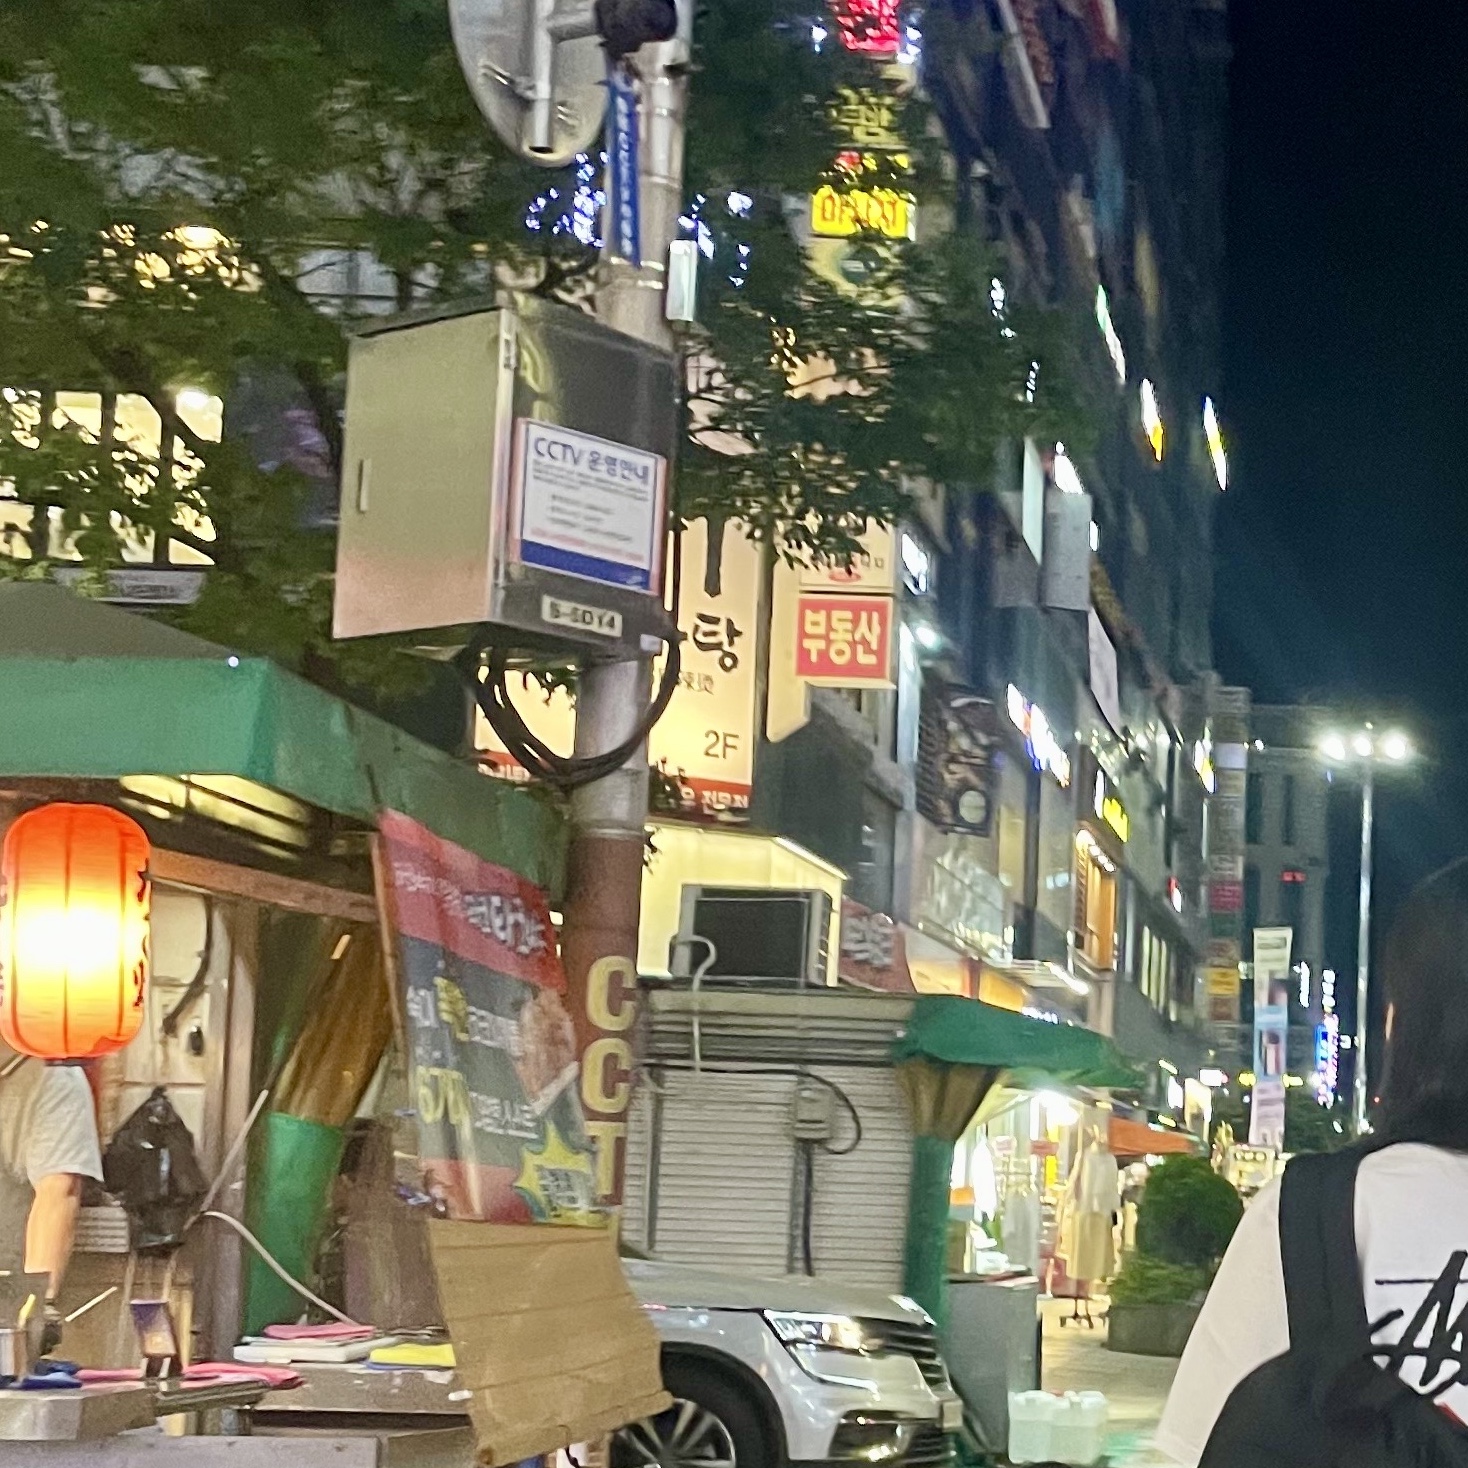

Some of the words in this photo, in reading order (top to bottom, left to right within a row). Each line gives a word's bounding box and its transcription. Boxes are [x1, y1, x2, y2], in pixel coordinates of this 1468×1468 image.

[534, 437, 585, 465] CCTV
[802, 609, 880, 665] 부동산
[704, 730, 739, 759] 2F
[582, 955, 637, 1195] CCT
